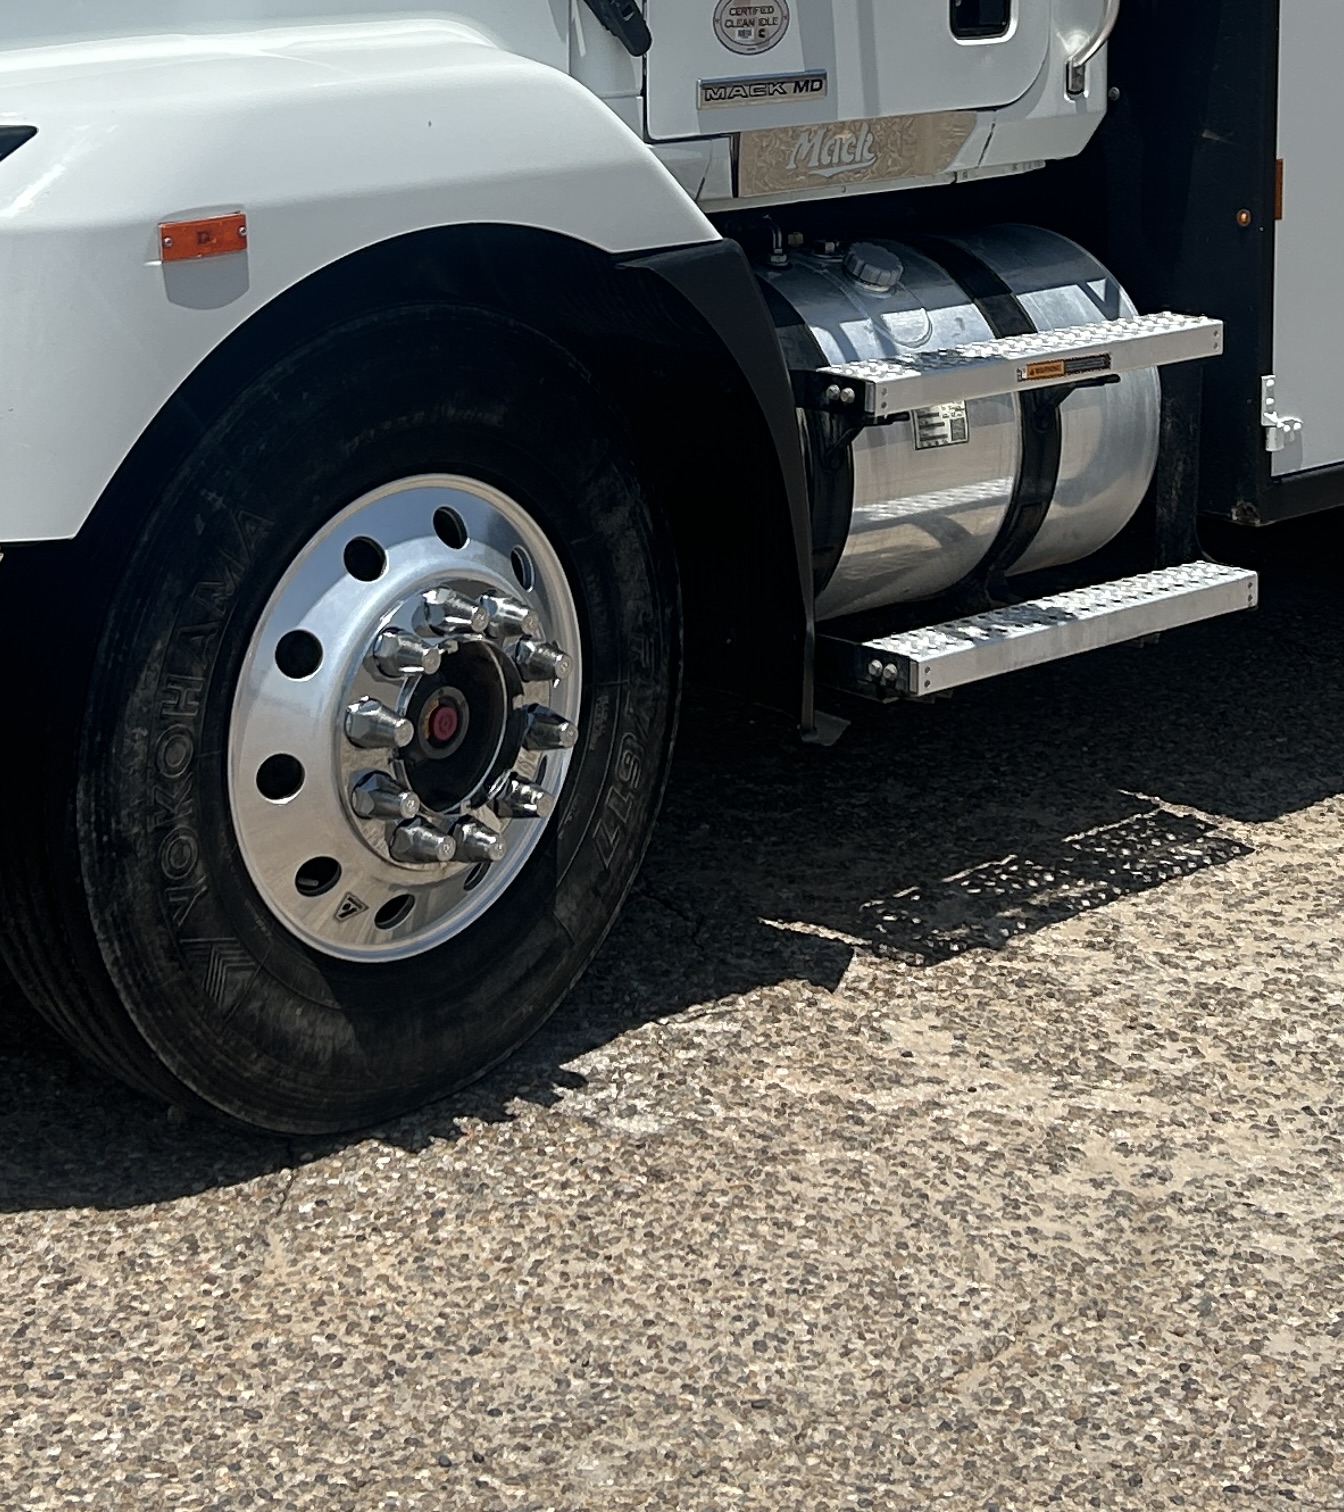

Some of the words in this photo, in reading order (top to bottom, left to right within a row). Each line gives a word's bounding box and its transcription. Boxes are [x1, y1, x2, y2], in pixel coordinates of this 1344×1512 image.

[729, 5, 774, 16] CERTIFIED
[724, 17, 755, 28] CLEAN
[704, 81, 787, 101] MACK
[793, 78, 823, 94] MD
[785, 122, 877, 178] Mack
[147, 506, 277, 928] YOKOHAMA
